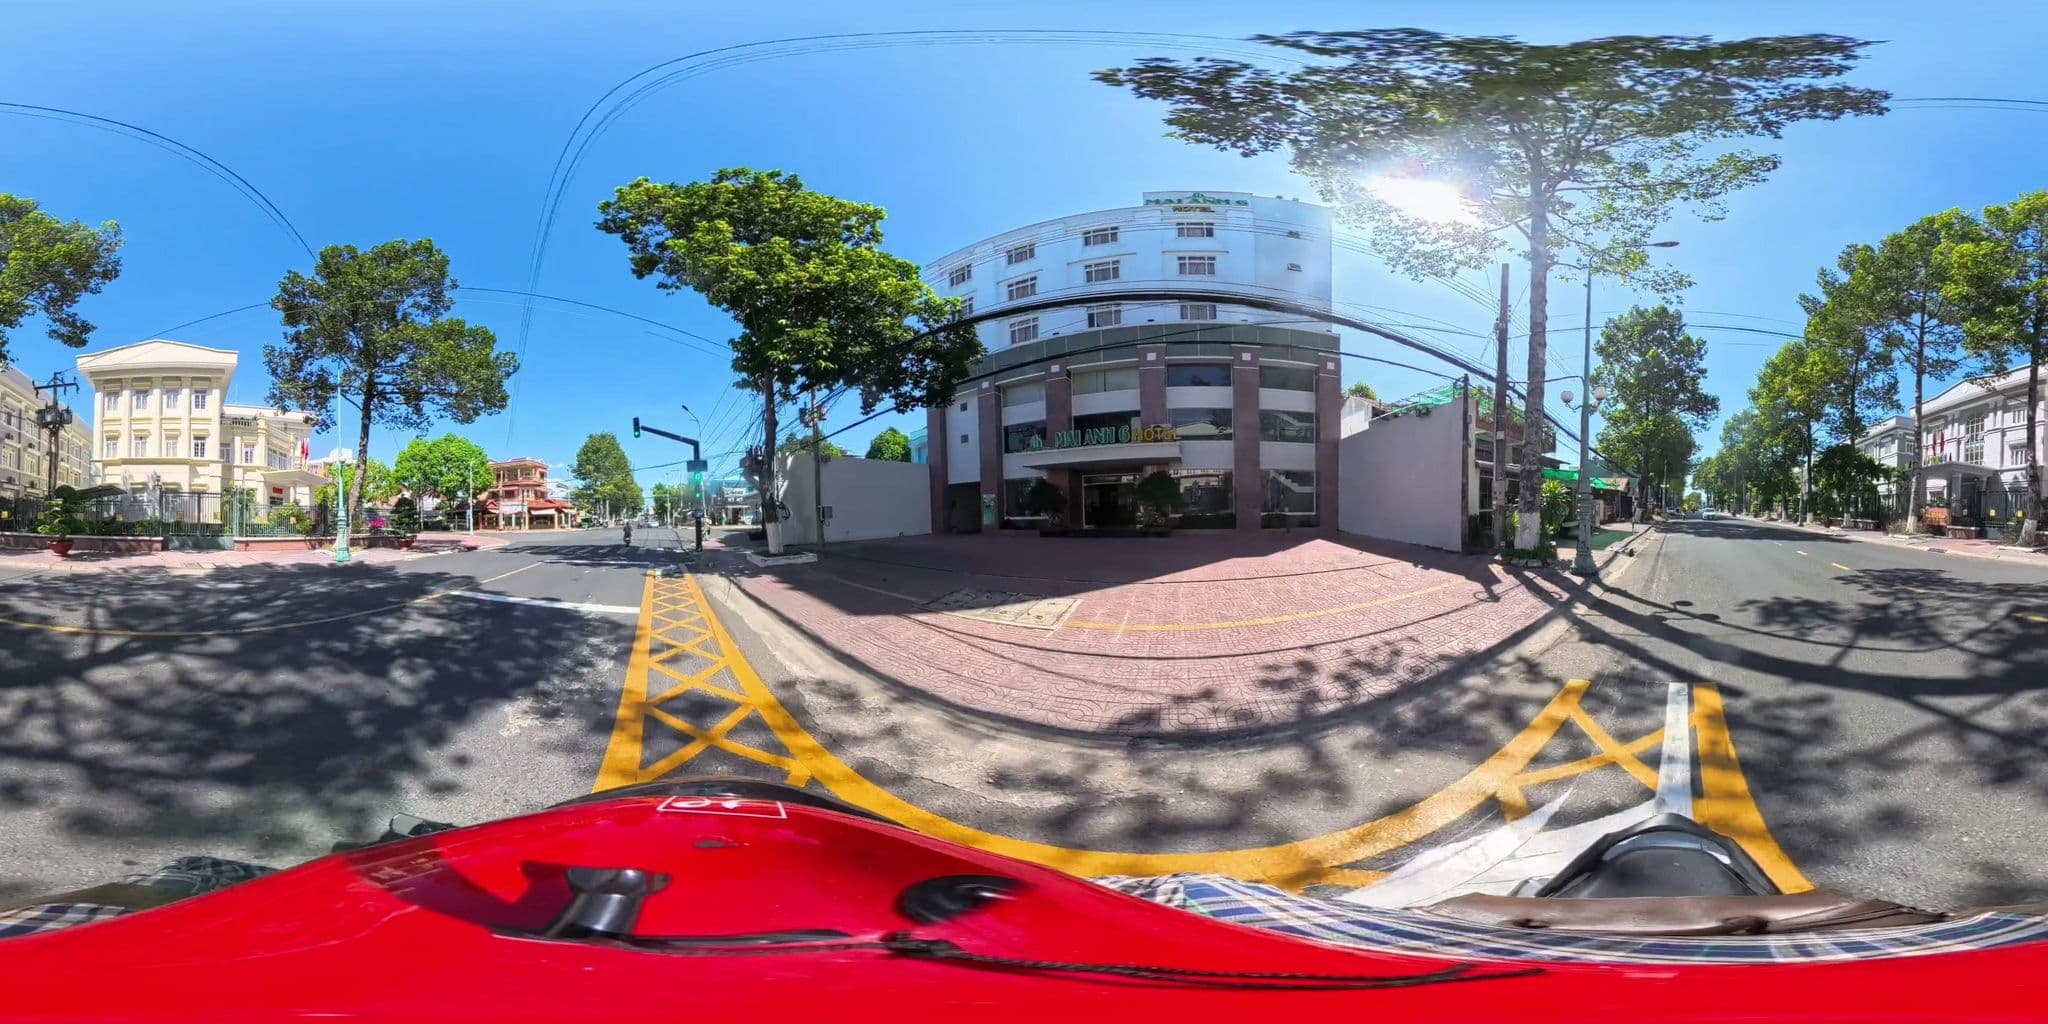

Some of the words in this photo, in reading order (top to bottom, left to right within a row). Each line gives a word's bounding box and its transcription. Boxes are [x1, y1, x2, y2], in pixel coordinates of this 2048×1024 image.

[1144, 198, 1182, 206] MAI
[1188, 198, 1231, 206] ANH
[1054, 429, 1081, 448] MAI
[1083, 426, 1116, 446] ANH
[1118, 425, 1131, 443] 6
[1131, 426, 1182, 441] HOTEL
